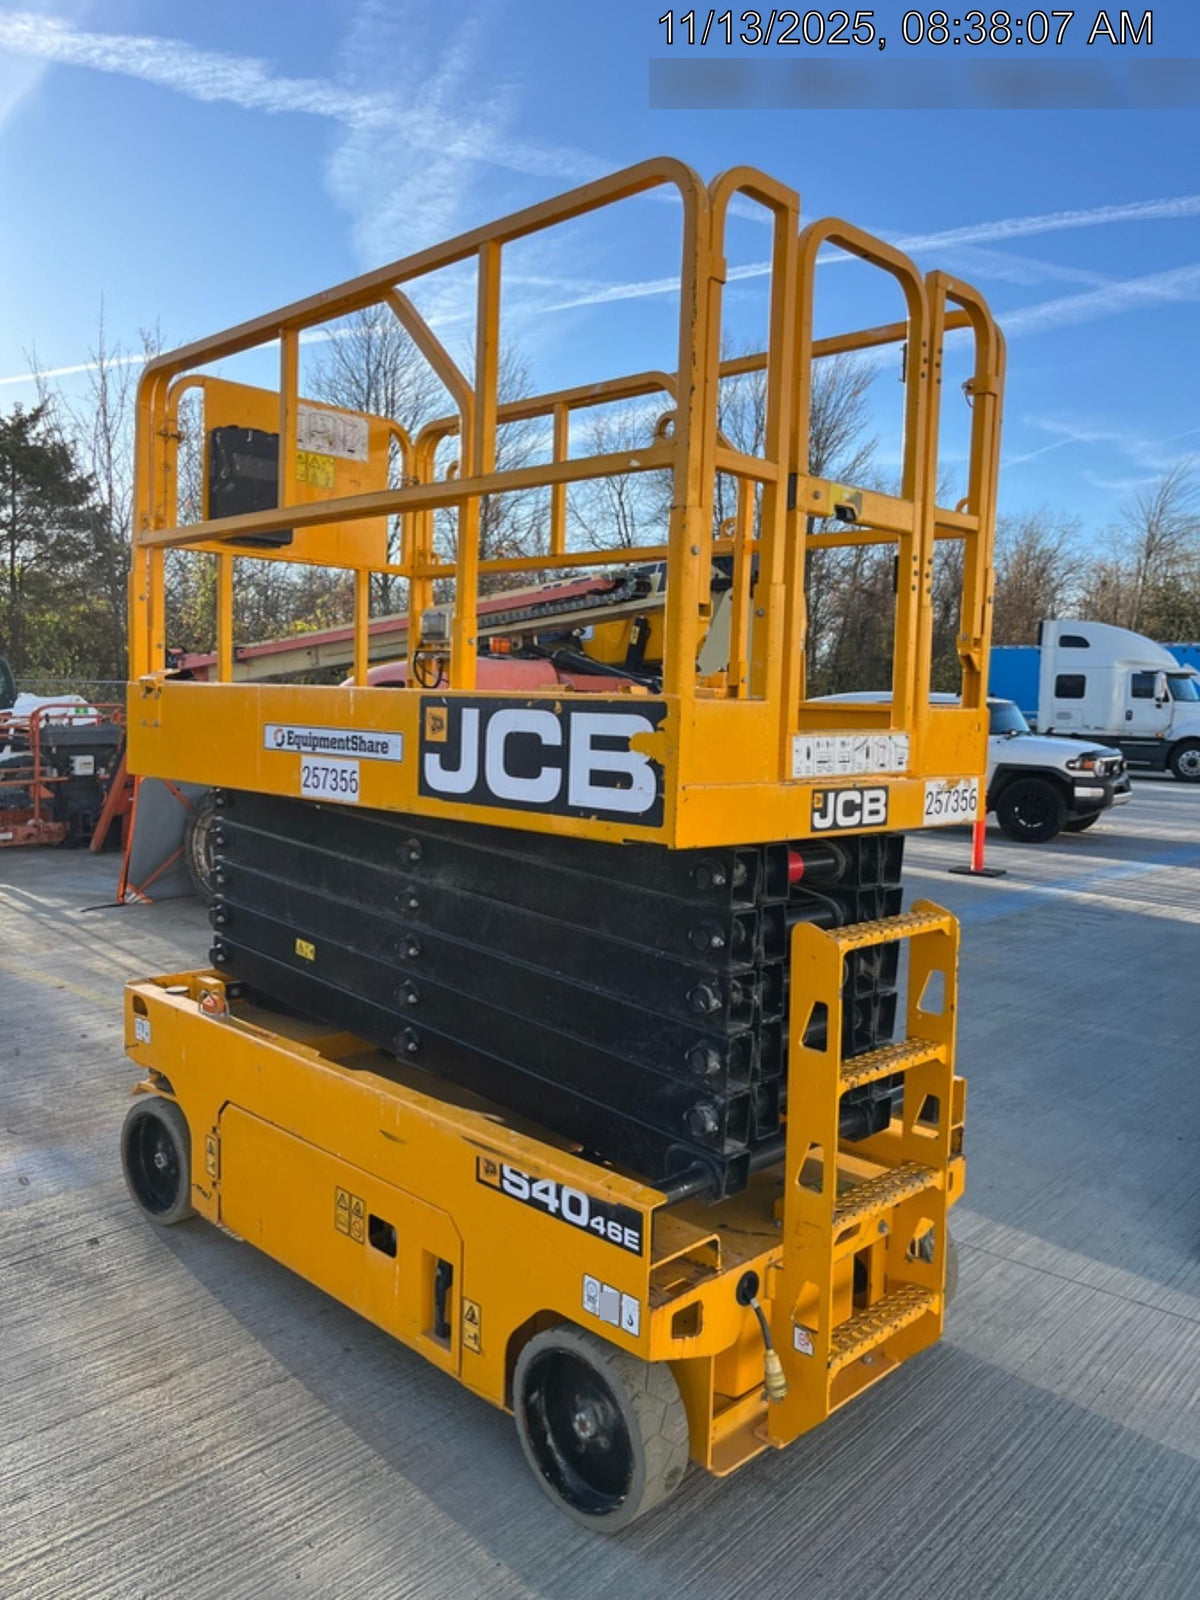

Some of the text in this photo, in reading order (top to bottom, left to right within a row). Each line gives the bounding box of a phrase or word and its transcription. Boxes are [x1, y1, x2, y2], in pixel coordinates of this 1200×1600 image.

[286, 730, 390, 755] EquipmentShare
[424, 707, 657, 813] JCB
[302, 765, 359, 794] 257356
[812, 789, 888, 830] JCB
[925, 788, 978, 816] 257356
